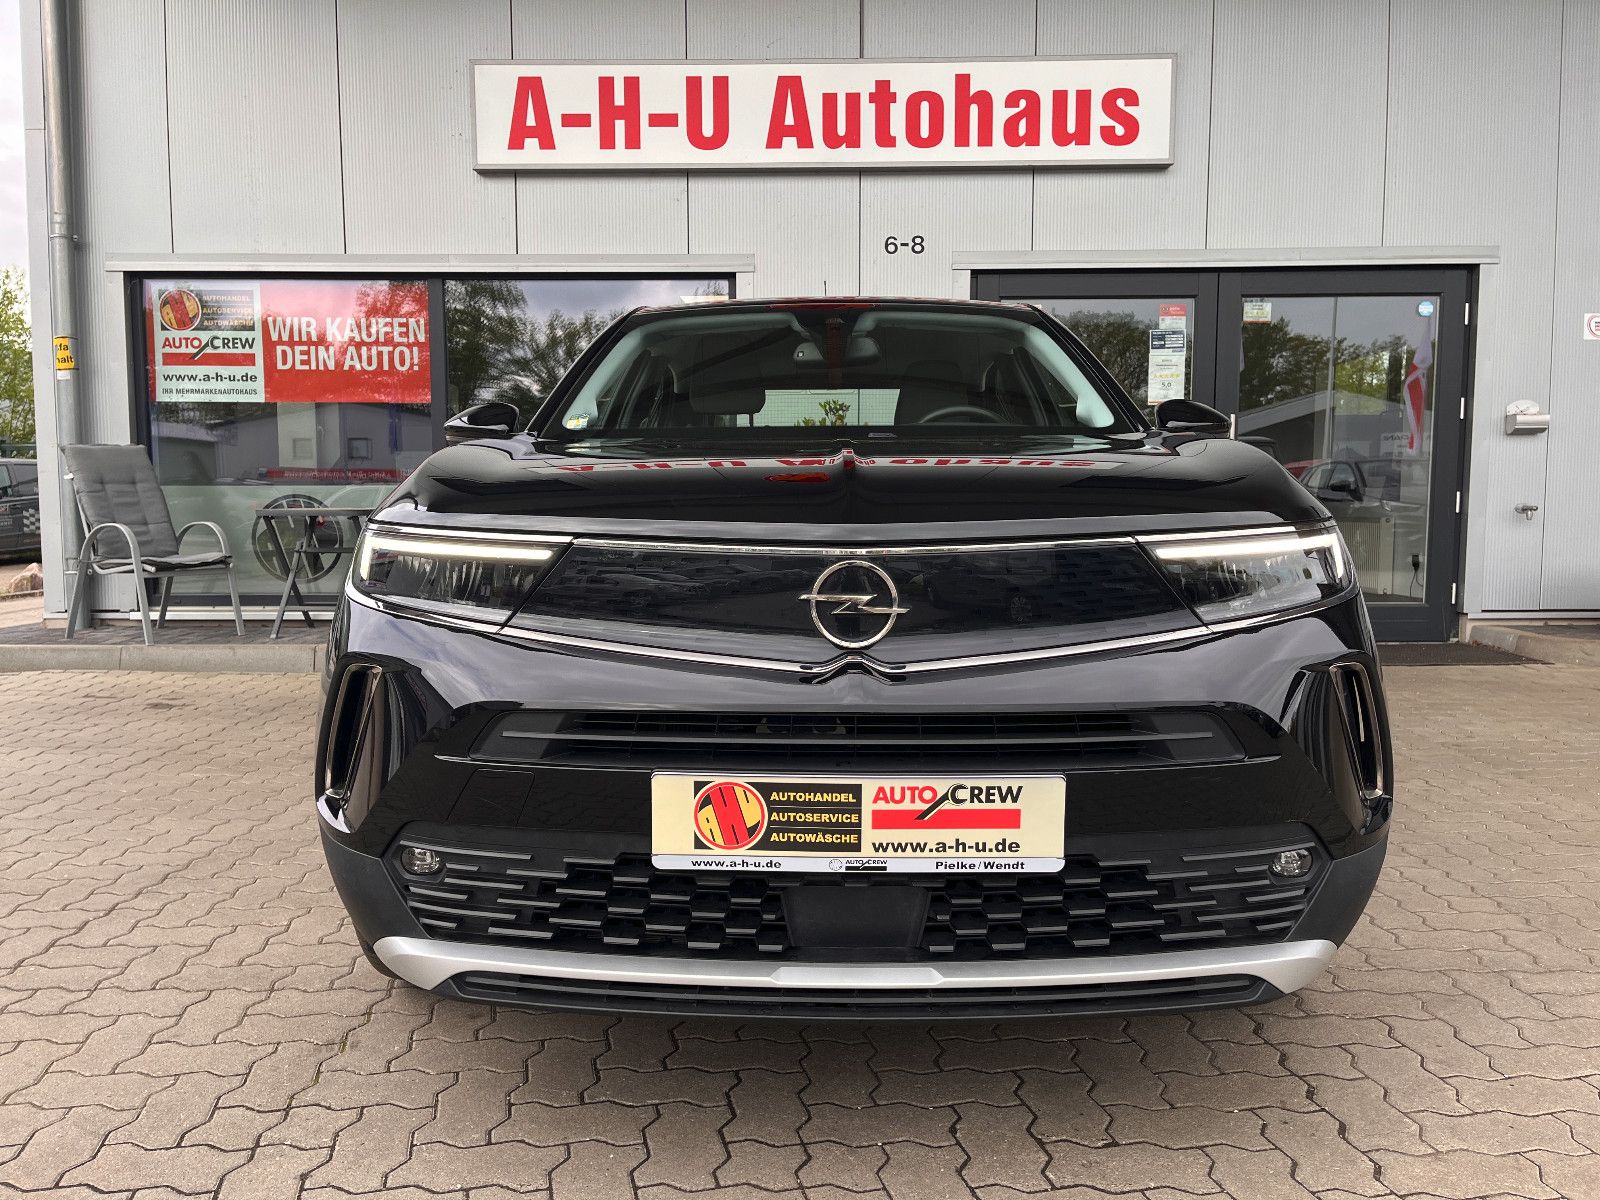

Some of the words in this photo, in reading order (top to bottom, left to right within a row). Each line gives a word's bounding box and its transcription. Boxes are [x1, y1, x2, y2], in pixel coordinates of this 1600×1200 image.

[507, 74, 730, 151] A-H-U
[765, 72, 1141, 149] Autohaus
[884, 235, 925, 255] 6-8
[267, 316, 318, 342] WIR
[326, 316, 426, 343] KAUFEN
[162, 336, 203, 349] AUTO
[209, 335, 256, 350] CREW
[276, 345, 336, 371] DEIN
[343, 346, 420, 371] AUTO!
[162, 372, 258, 383] www.a-h-u.de
[175, 388, 258, 396] MEHRMARKENAUTOHAUS
[770, 791, 857, 803] AUTOHANDEL
[872, 785, 938, 804] AUTO
[947, 783, 1023, 805] CREW
[770, 812, 859, 823] AUTOSERVICE
[770, 832, 859, 844] AUTOWÄSCHE
[871, 838, 1021, 853] www.a-h-u.de
[691, 859, 782, 869] www.a-h-u.de
